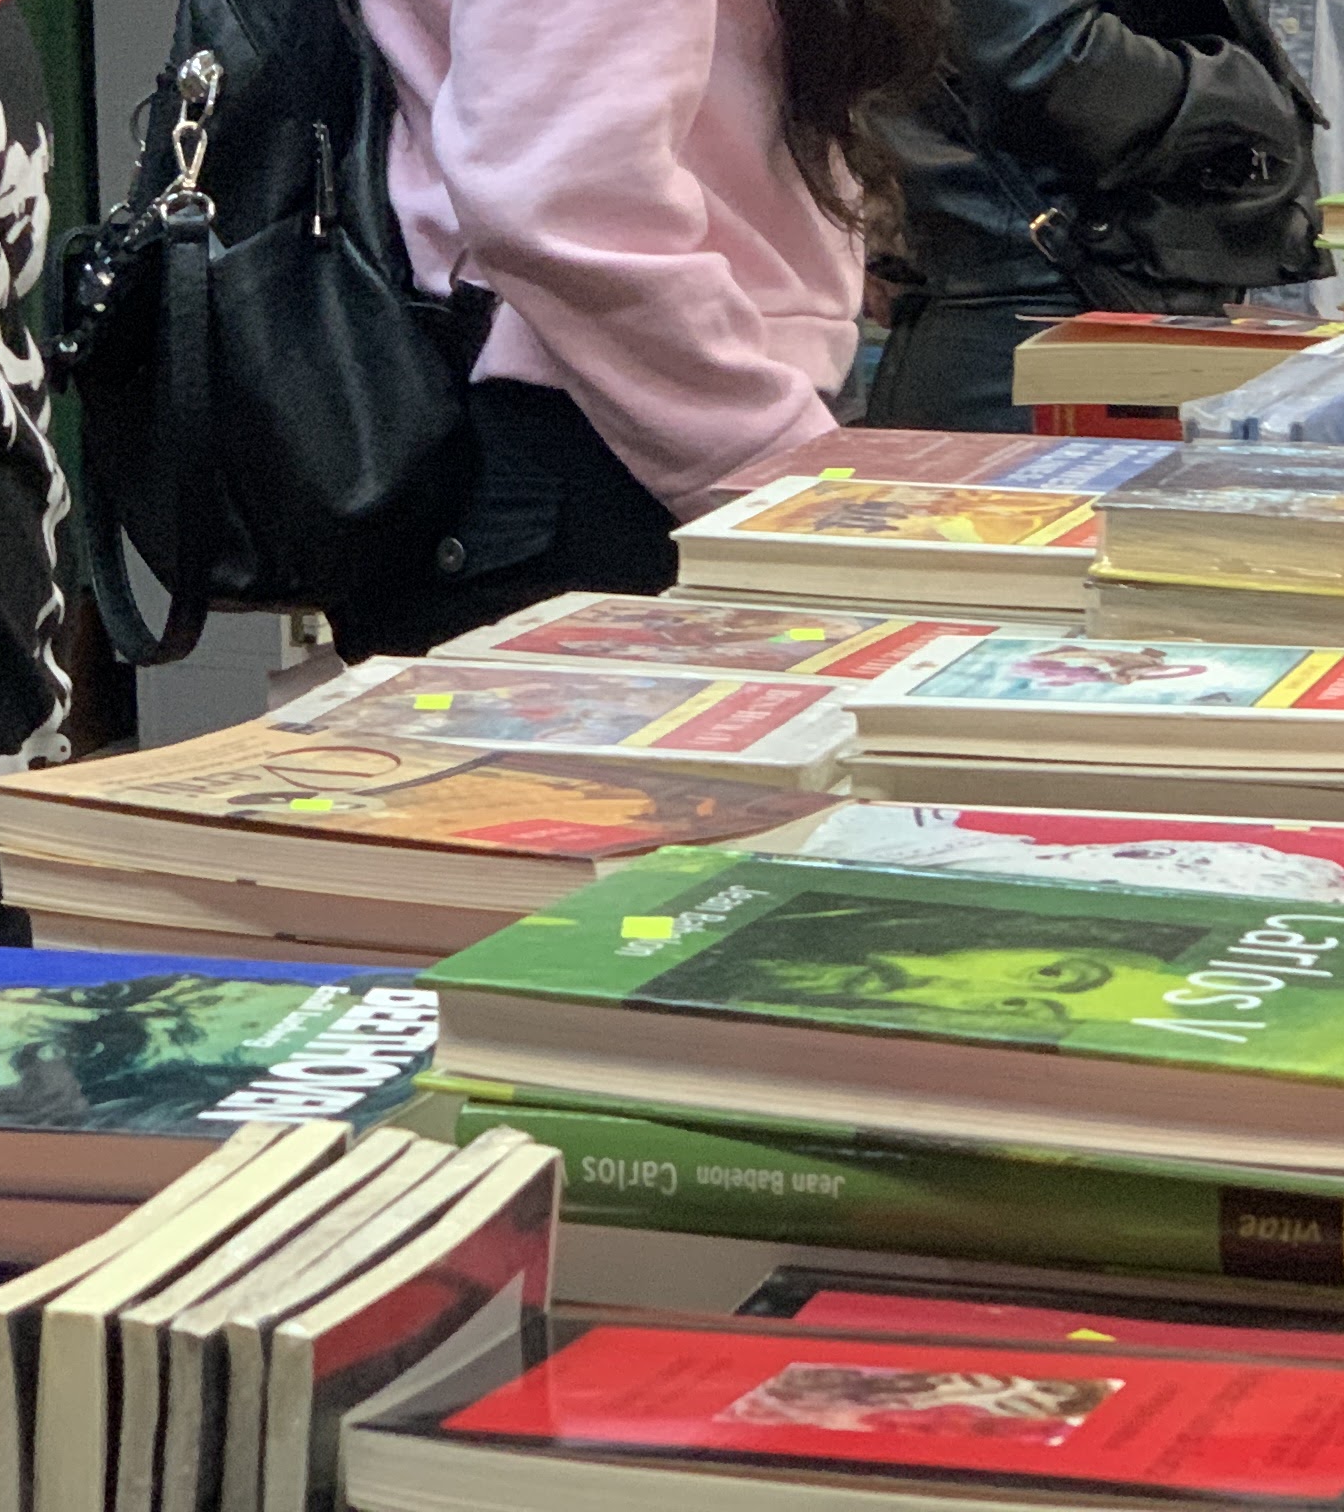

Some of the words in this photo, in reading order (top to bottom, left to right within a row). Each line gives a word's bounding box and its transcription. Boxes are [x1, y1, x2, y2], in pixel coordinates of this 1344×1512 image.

[695, 885, 770, 911] Jean
[300, 985, 351, 1011] Emil
[241, 1011, 323, 1049] Ludwig
[1130, 1017, 1267, 1044] V
[196, 987, 439, 1123] BEETHOVEN
[582, 1155, 678, 1195] Carlos
[697, 1166, 785, 1195] Babelon
[792, 1172, 846, 1199] Jean
[1239, 1214, 1322, 1243] vitae
